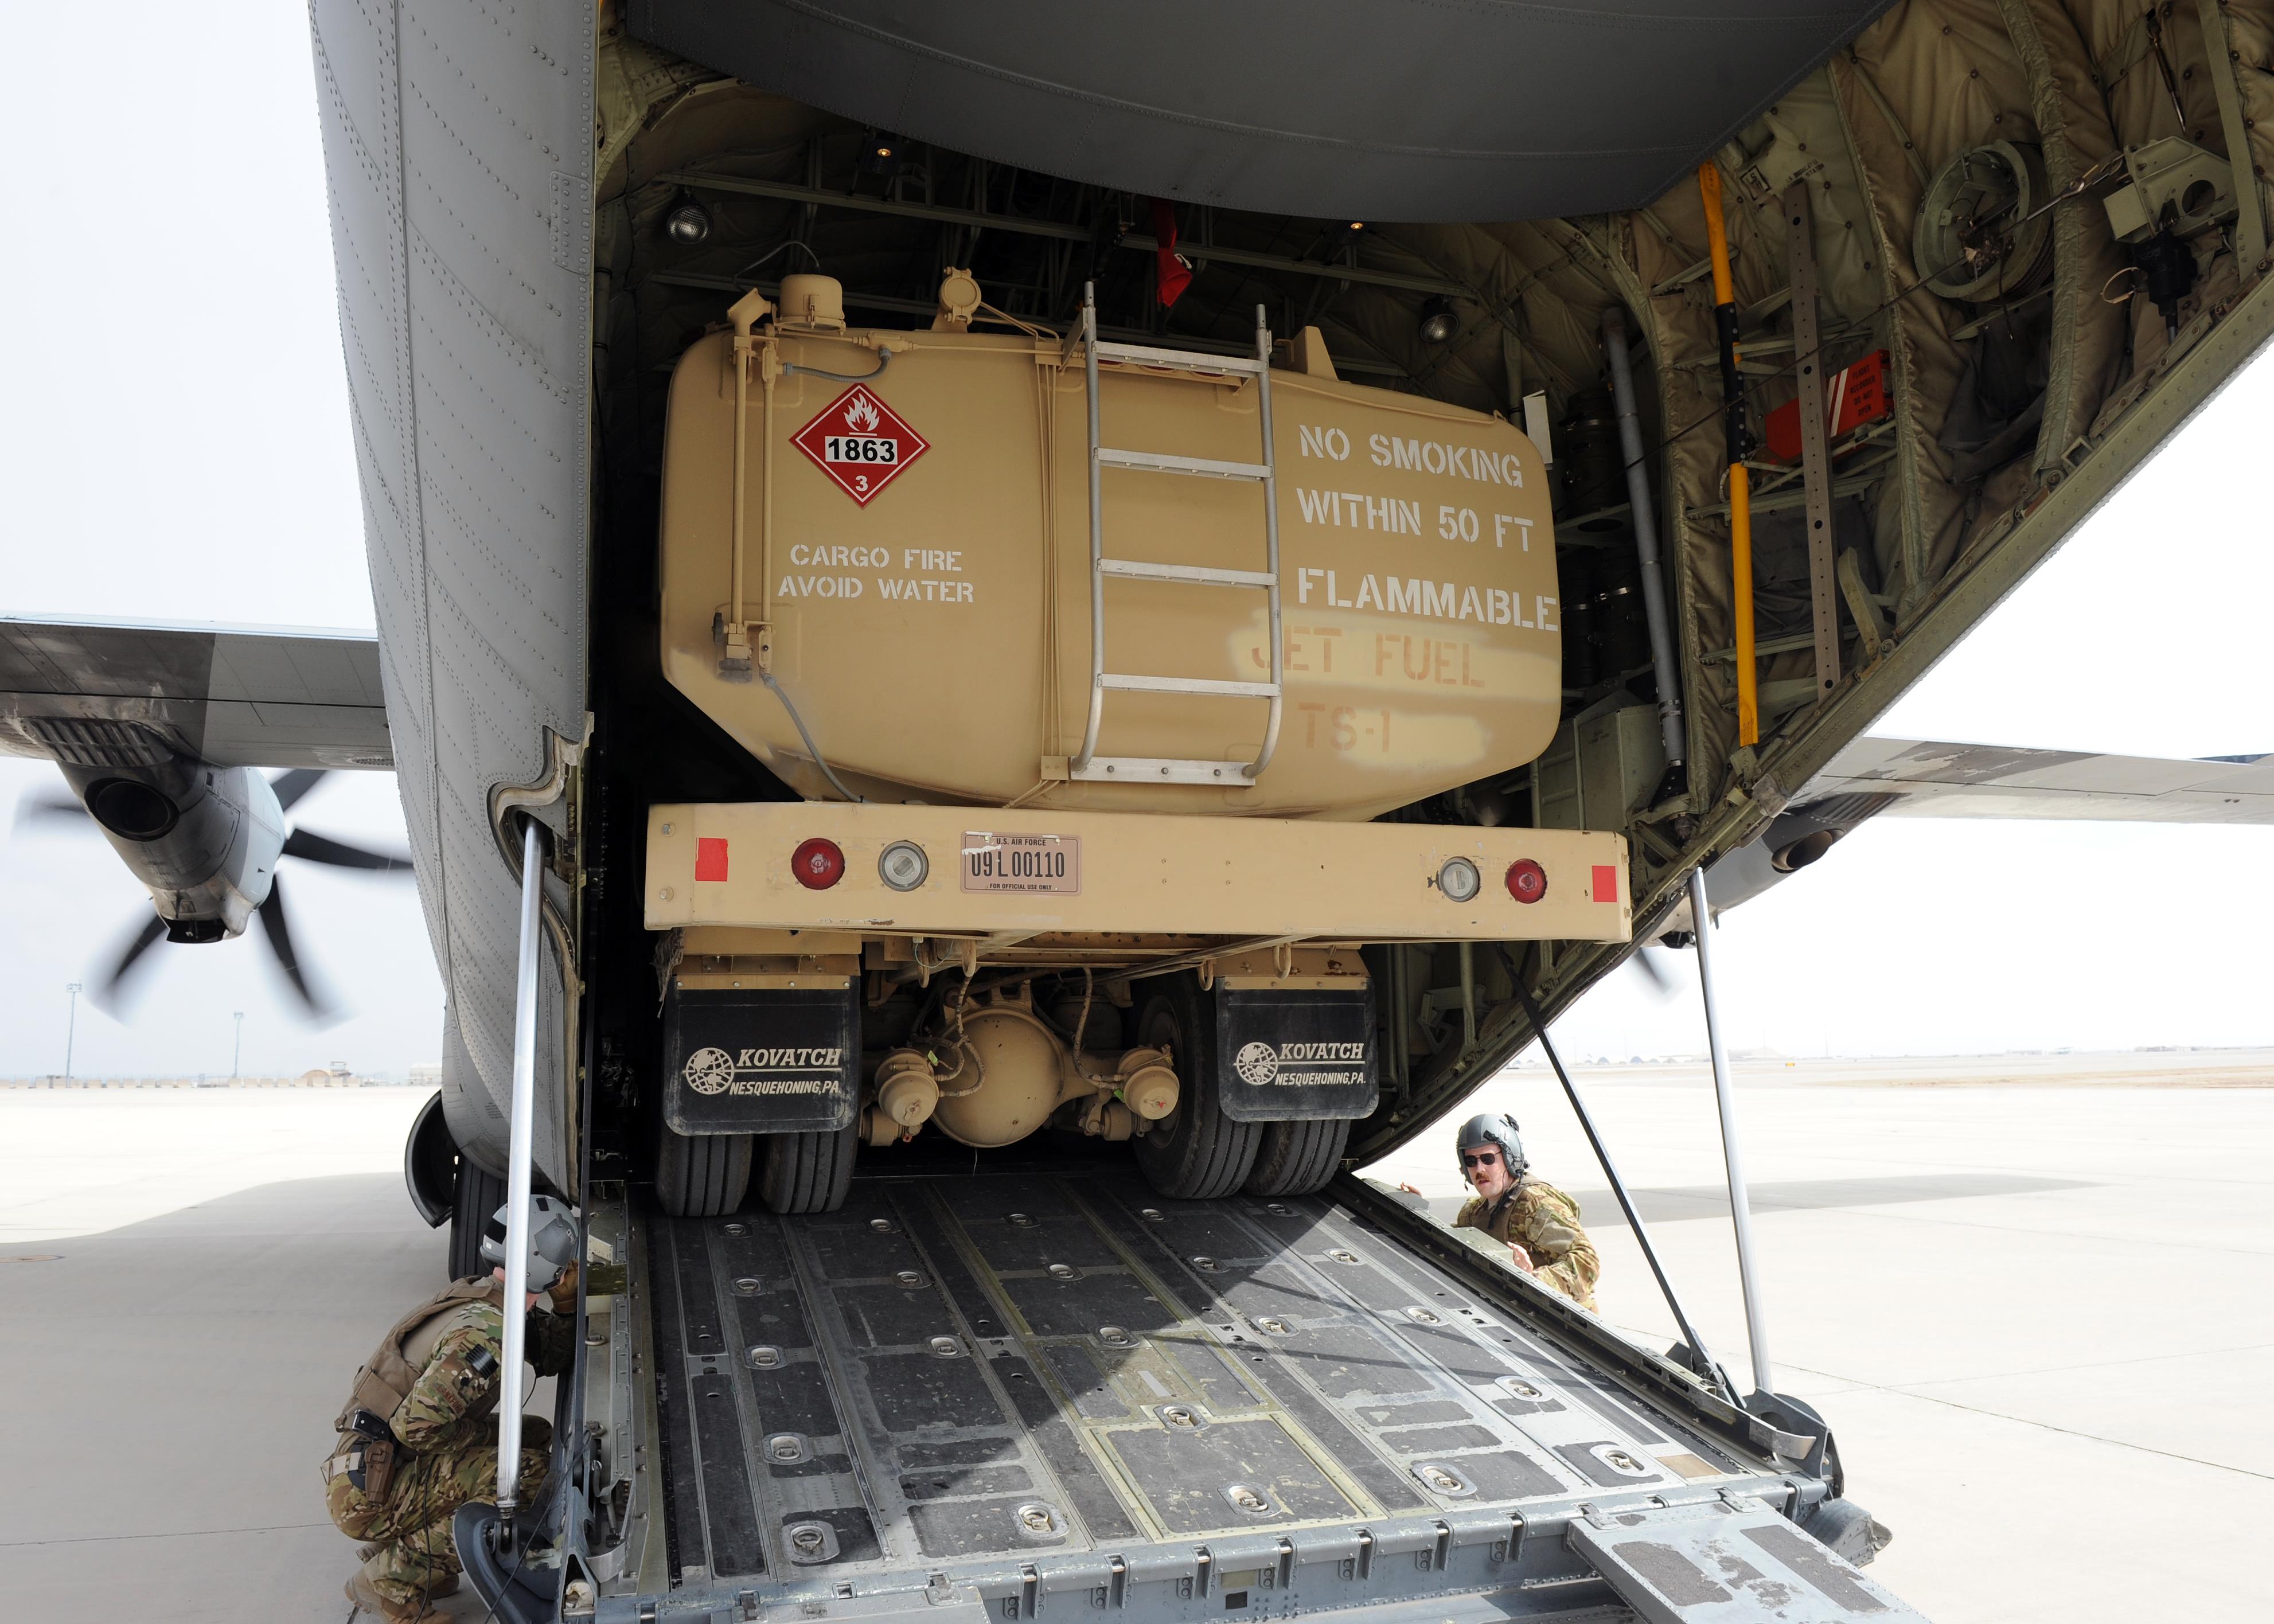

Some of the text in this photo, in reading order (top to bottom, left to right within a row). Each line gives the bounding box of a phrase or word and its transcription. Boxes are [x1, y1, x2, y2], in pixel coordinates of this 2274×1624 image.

[828, 438, 895, 462] 1863
[1299, 425, 1523, 488] NO SMOKING
[855, 475, 868, 491] 3
[1296, 488, 1534, 552] WITHIN 50 FT
[790, 544, 962, 571] CARGO FIRE
[778, 576, 973, 603] AVOID WATER
[1298, 567, 1558, 631] FLAMMABLE
[1376, 633, 1485, 688] FUEL
[1298, 702, 1391, 752] TS-1
[736, 1048, 842, 1067] KOVATCH
[1279, 1043, 1364, 1060] KOVATCH
